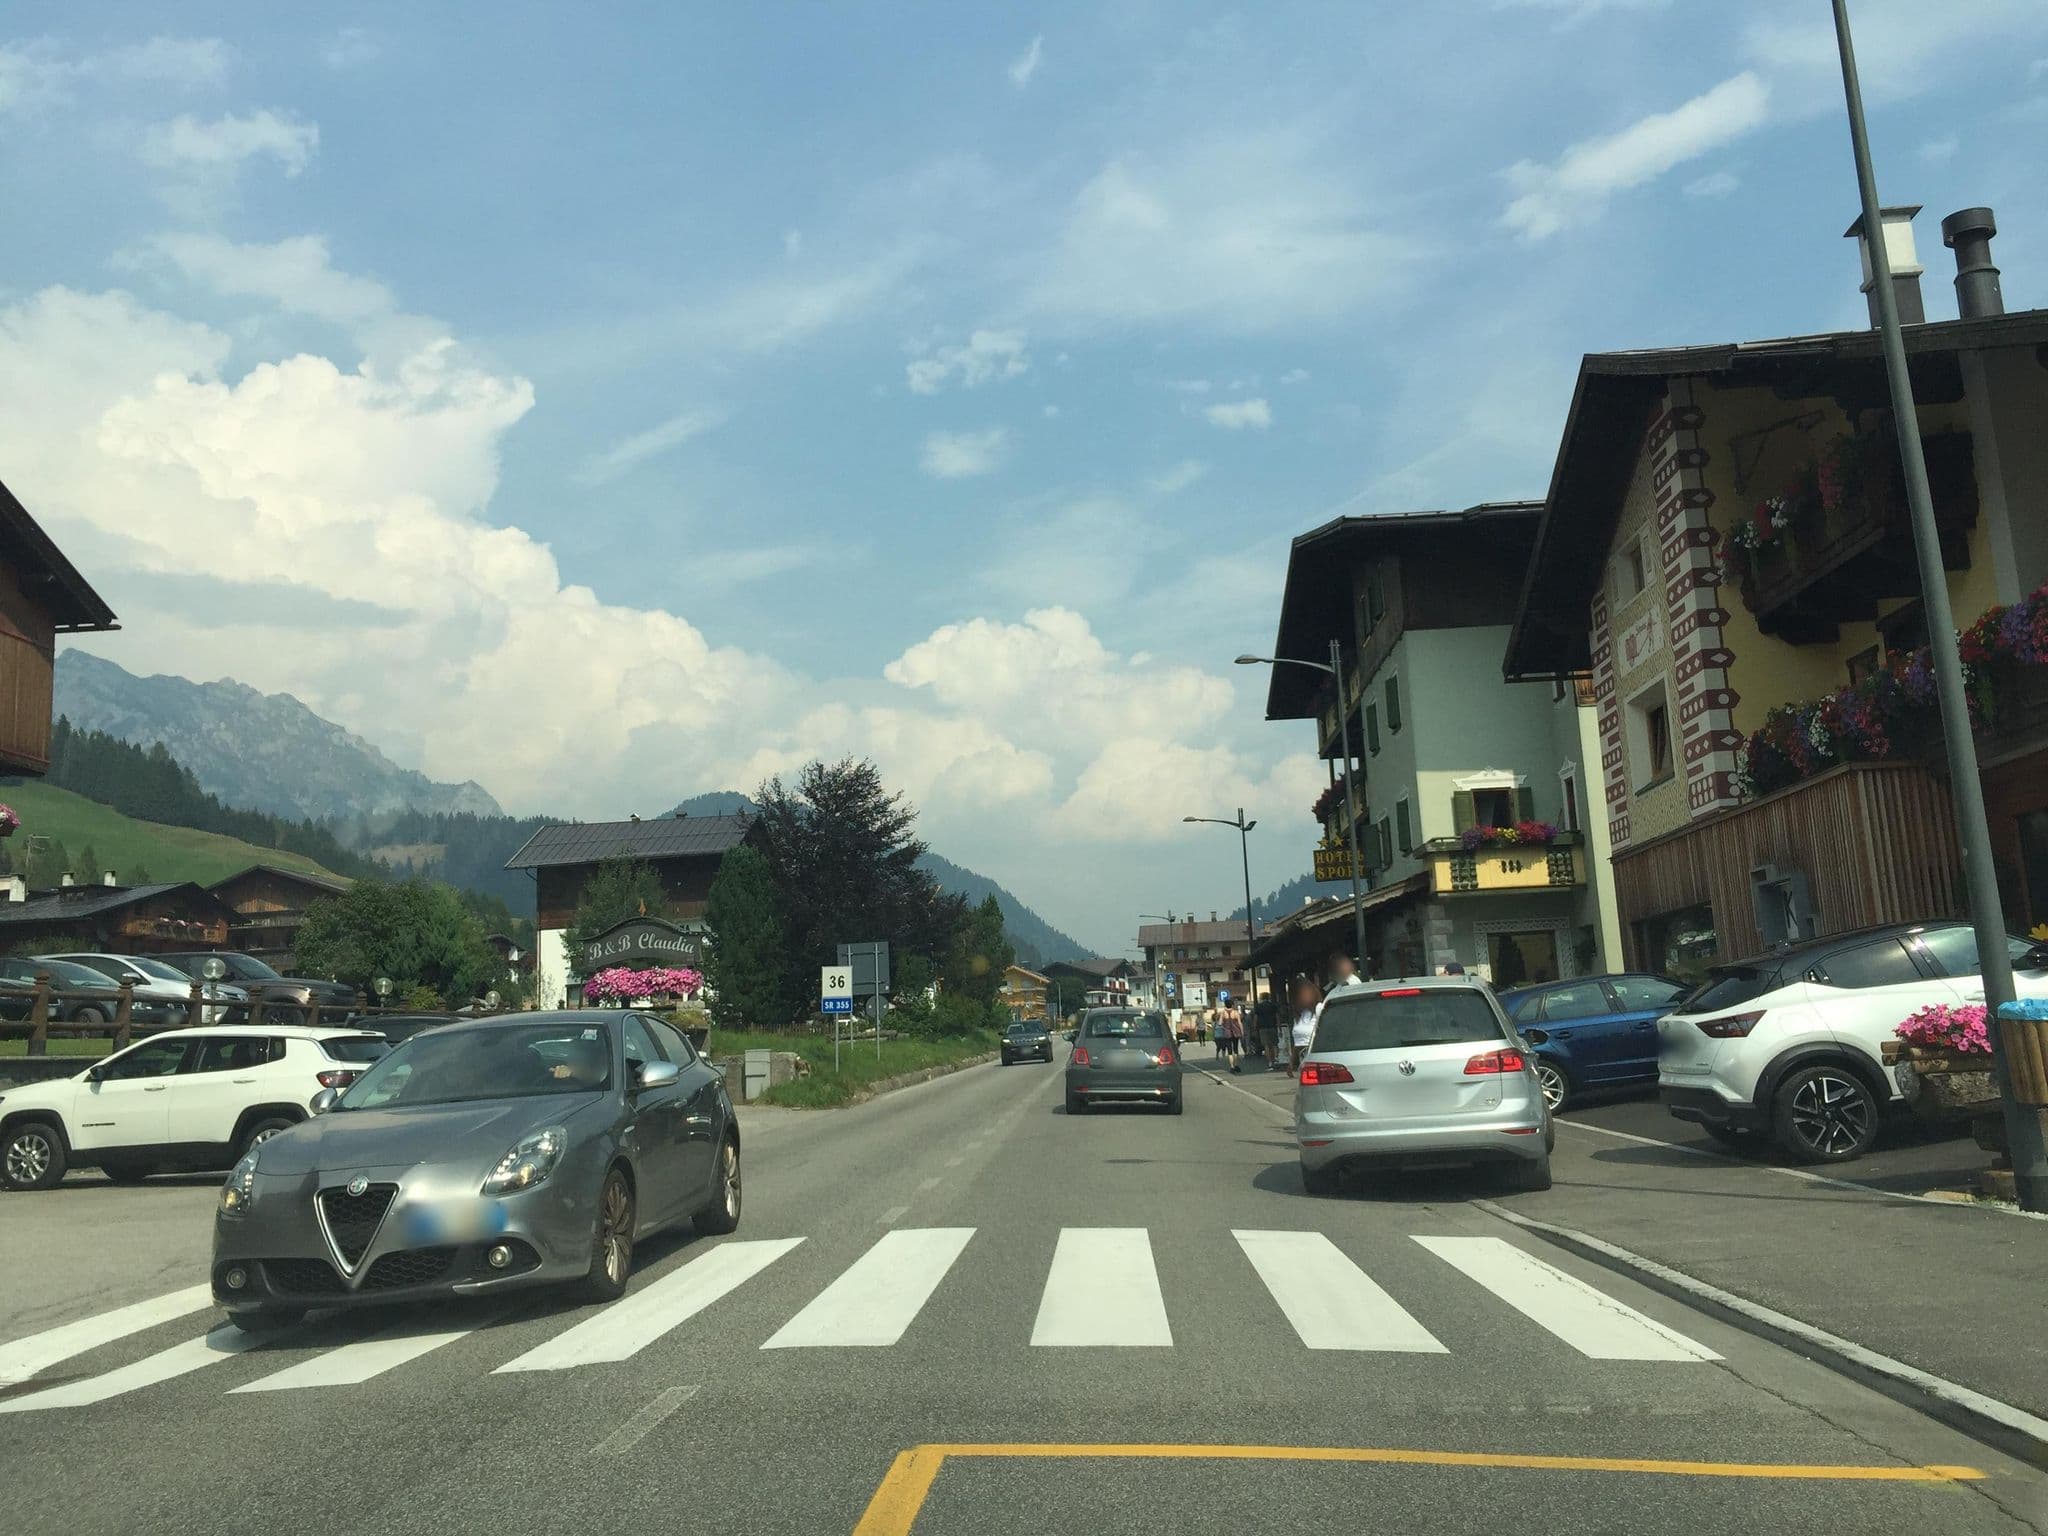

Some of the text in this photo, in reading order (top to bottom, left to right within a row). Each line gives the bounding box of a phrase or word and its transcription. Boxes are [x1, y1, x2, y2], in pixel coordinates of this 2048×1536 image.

[638, 932, 695, 954] Claudia
[829, 975, 845, 988] 36
[1220, 991, 1228, 1000] P
[824, 1000, 849, 1009] SR 355
